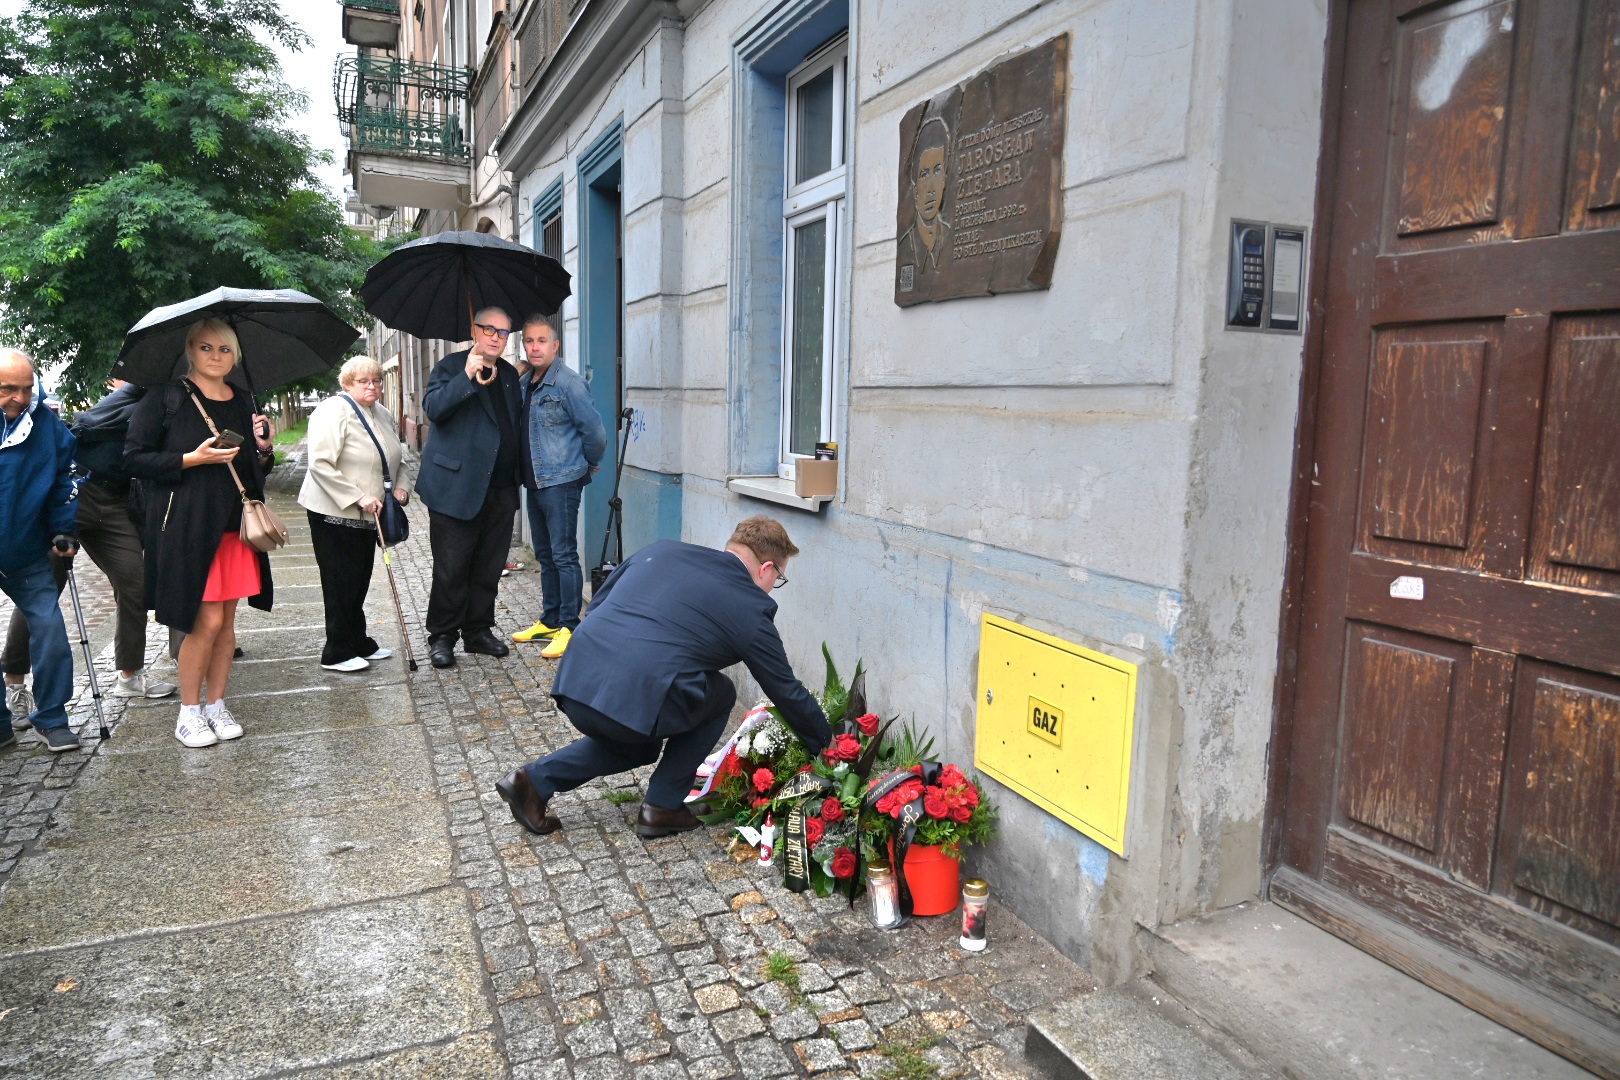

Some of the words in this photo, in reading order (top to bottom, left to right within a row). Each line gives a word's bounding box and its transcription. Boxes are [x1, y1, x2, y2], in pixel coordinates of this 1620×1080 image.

[958, 128, 1035, 175] JAROSŁAW
[957, 160, 1022, 200] ZIĘTARA
[998, 203, 1018, 221] 1992
[1033, 706, 1058, 737] GAZ
